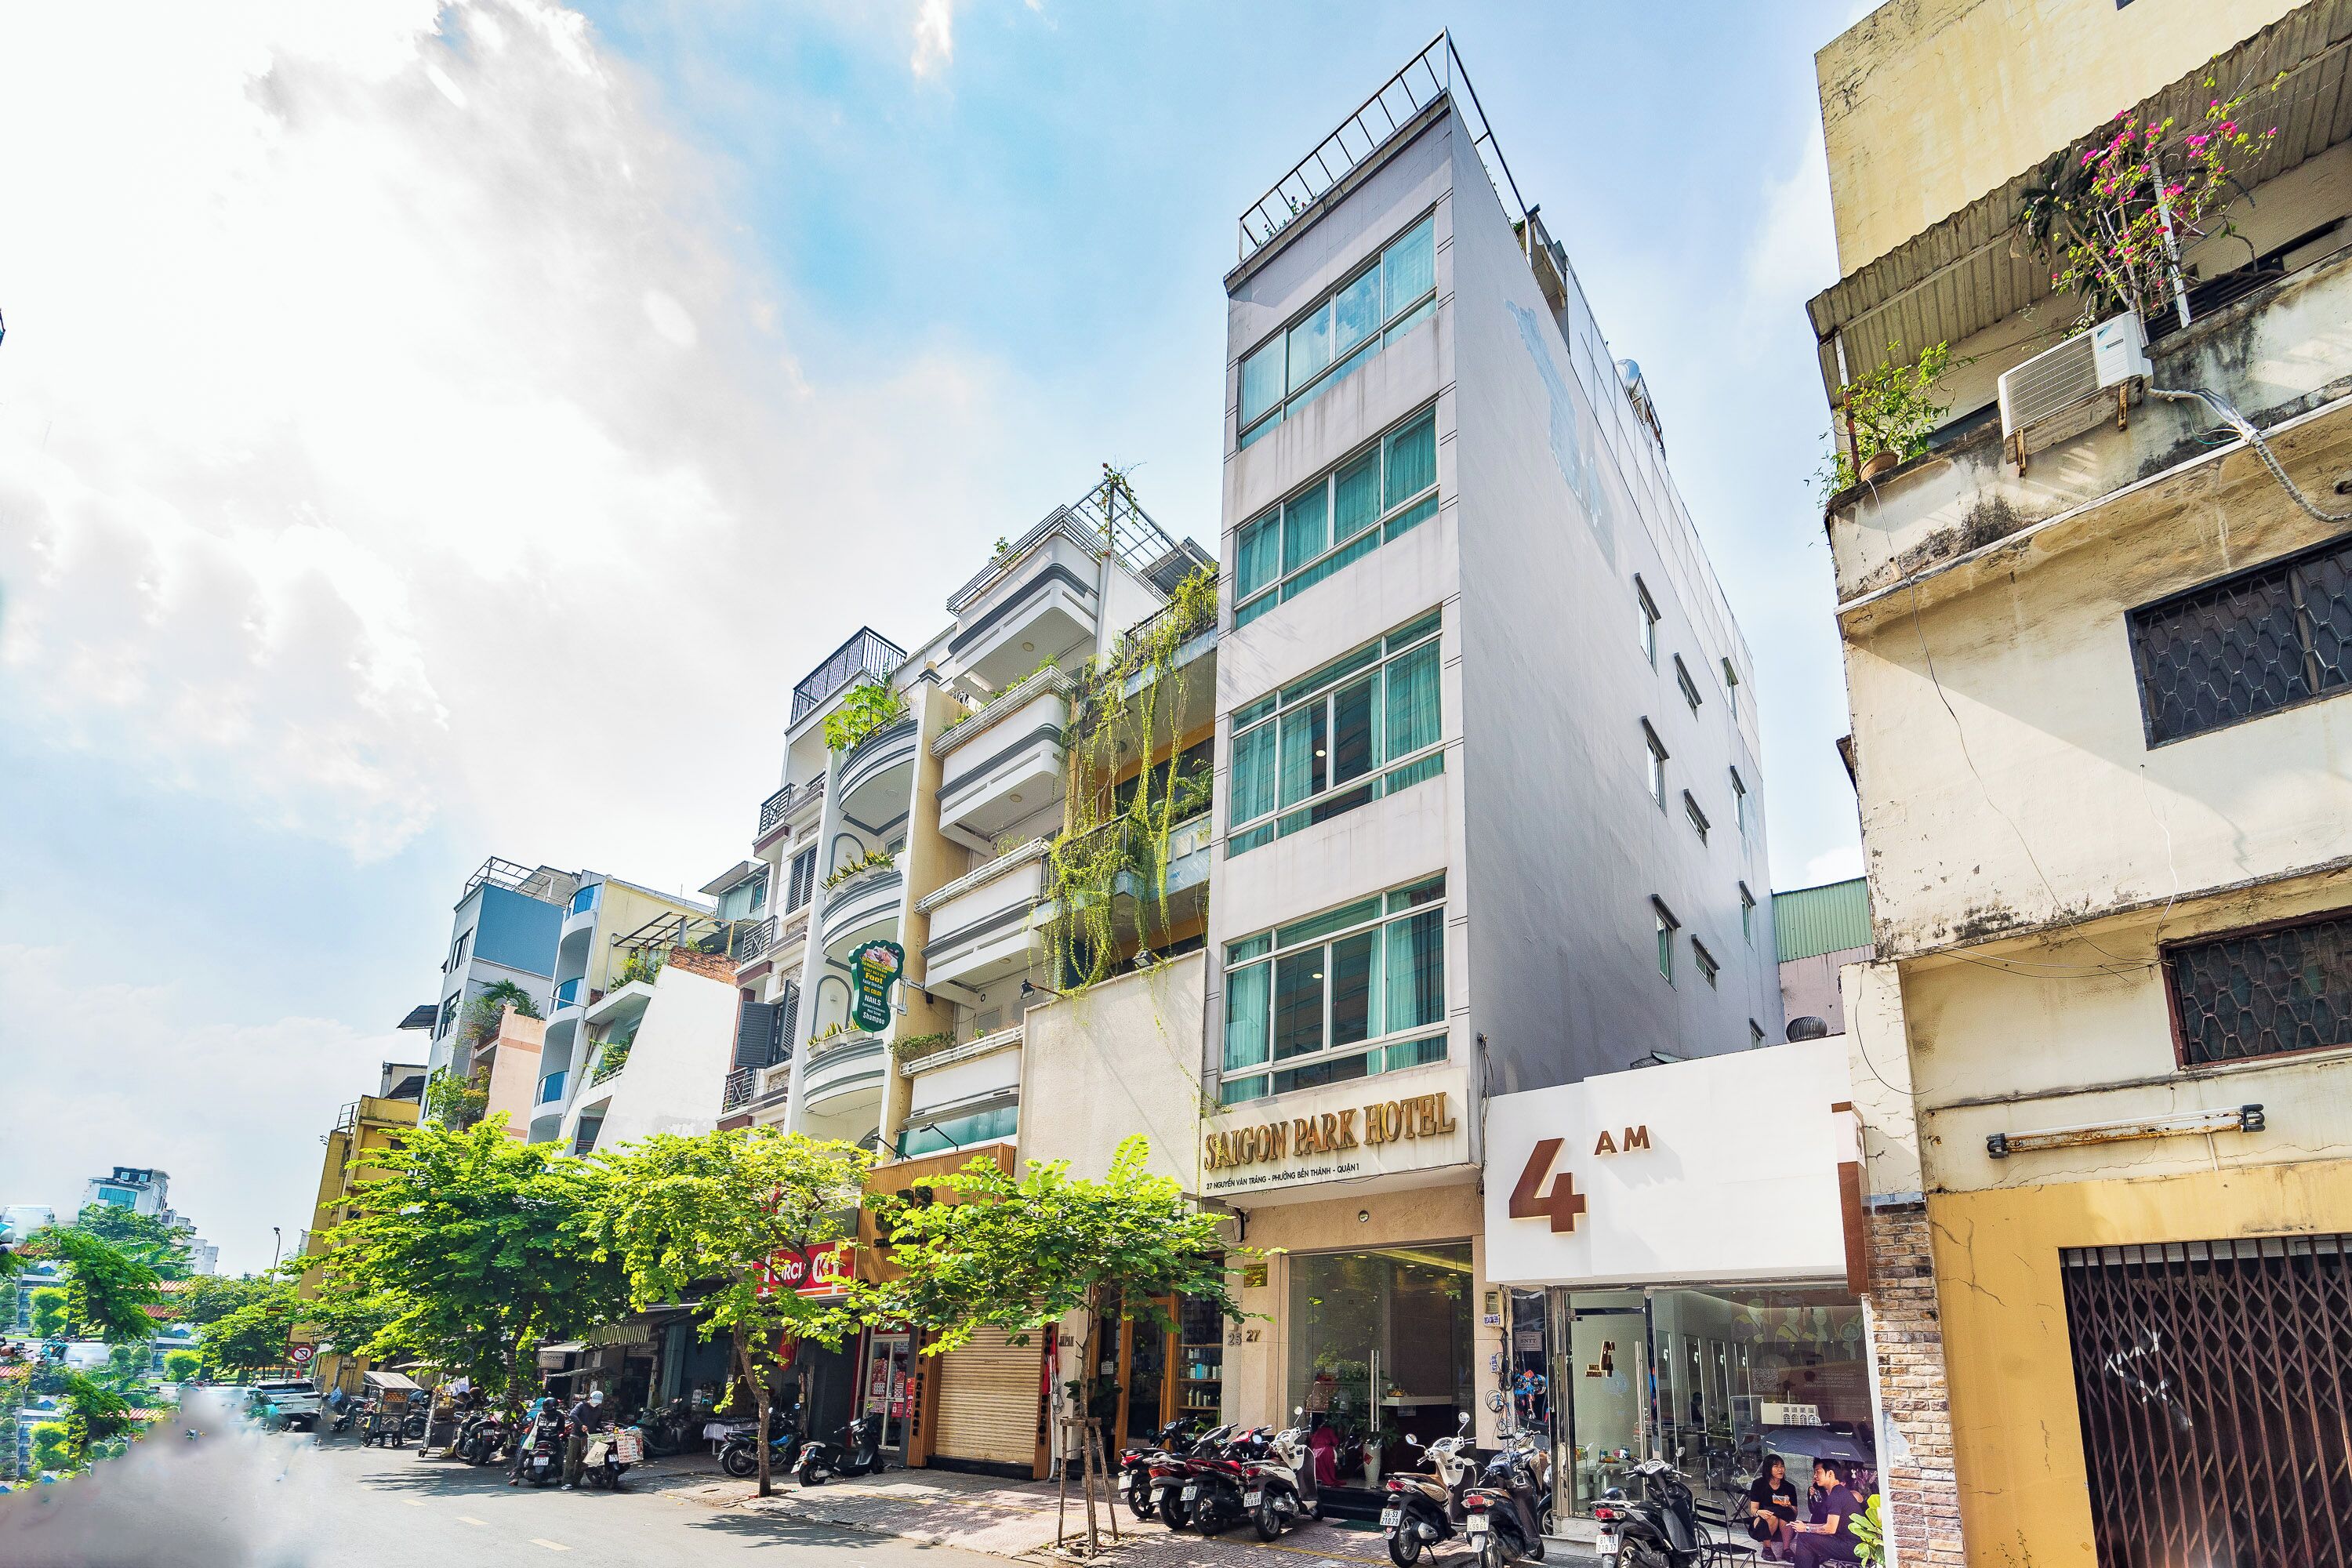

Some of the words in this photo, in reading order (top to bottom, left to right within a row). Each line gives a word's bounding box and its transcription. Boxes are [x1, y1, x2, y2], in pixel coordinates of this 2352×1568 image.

[865, 971, 883, 984] Foot
[864, 995, 882, 1006] NAILS
[863, 1012, 885, 1025] Shampoo
[1204, 1120, 1288, 1171] SAIGON
[1293, 1108, 1359, 1156] PARK
[1363, 1091, 1456, 1145] HOTEL
[1297, 1167, 1309, 1178] BẾN
[1310, 1166, 1331, 1177] THÀNH
[1337, 1163, 1355, 1174] QUẬN
[1508, 1137, 1587, 1235] 4
[1594, 1124, 1652, 1156] AM
[1246, 1329, 1261, 1342] 27
